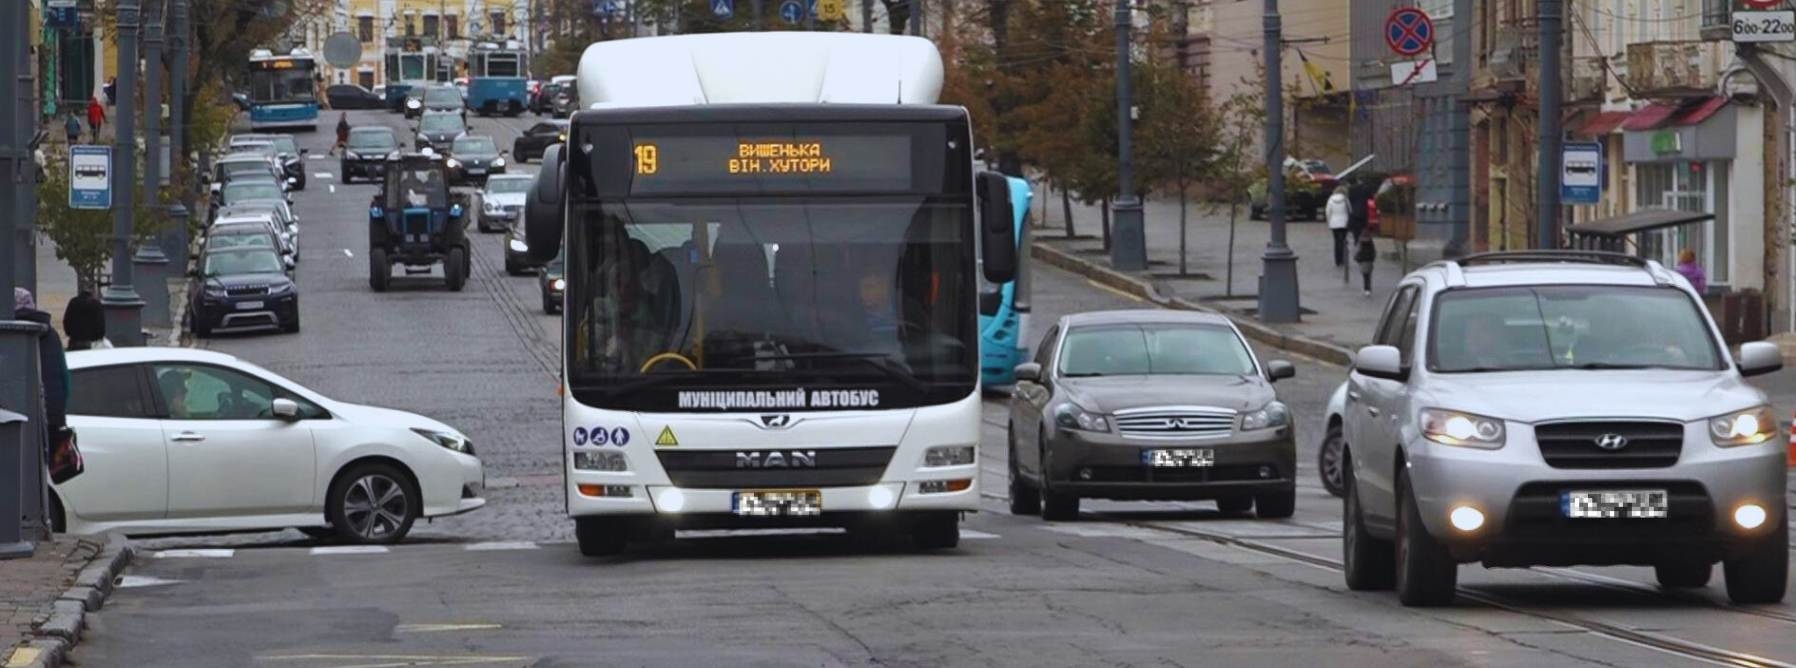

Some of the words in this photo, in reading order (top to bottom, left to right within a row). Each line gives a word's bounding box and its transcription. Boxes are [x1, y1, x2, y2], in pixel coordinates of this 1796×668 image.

[634, 145, 657, 174] 19
[739, 143, 821, 158] ВИШЕНЬКА
[678, 387, 807, 410] МУНІЦИПАЛЬНИЙ
[810, 389, 880, 407] АВТОБУС
[735, 451, 817, 468] MAN
